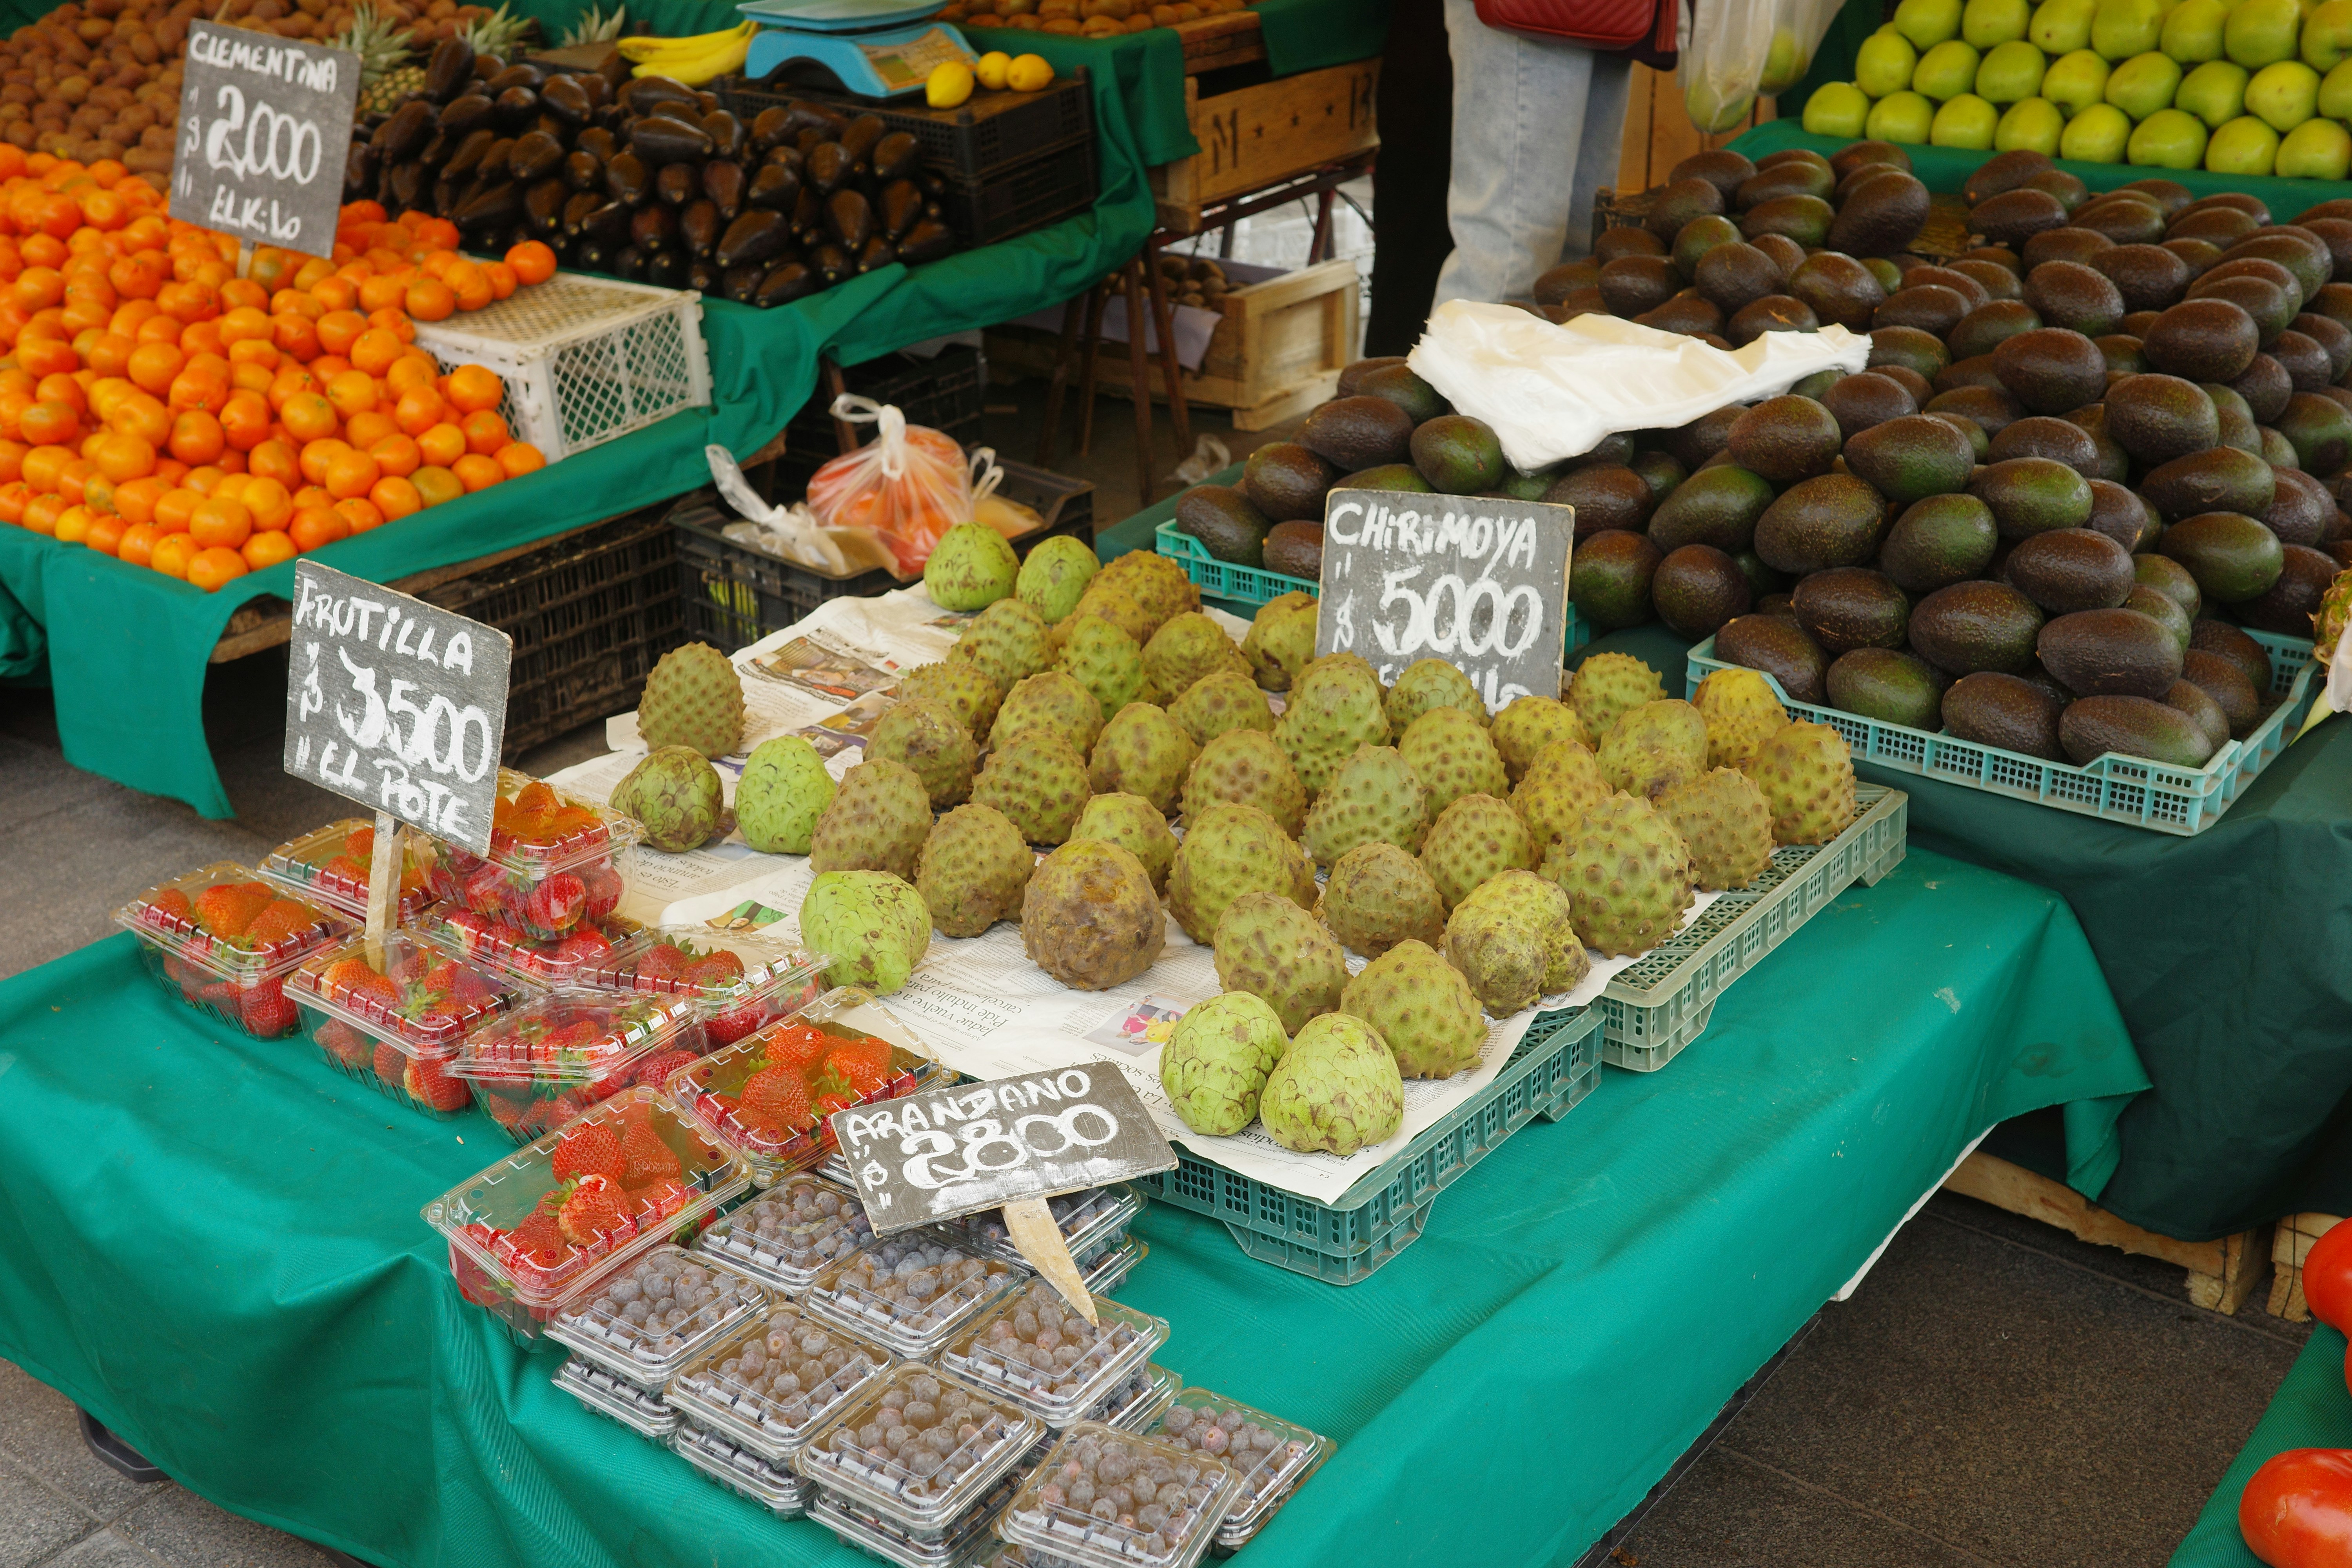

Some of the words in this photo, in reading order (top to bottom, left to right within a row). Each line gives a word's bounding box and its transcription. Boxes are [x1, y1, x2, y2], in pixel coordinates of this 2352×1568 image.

[206, 85, 322, 184] 2000
[1372, 564, 1543, 657] 5000
[336, 645, 492, 783] 3500
[920, 973, 952, 986] para
[880, 996, 897, 1005] pasar
[895, 1004, 914, 1012] puede
[913, 998, 954, 1020] vuelve
[931, 990, 977, 1014] indulto
[973, 994, 1022, 1013] cárceles
[912, 1011, 933, 1020] pueblo
[978, 1009, 1008, 1027] Pide
[956, 1017, 997, 1036] Jadue
[959, 1031, 982, 1041] Además
[900, 1103, 1119, 1189] 2800
